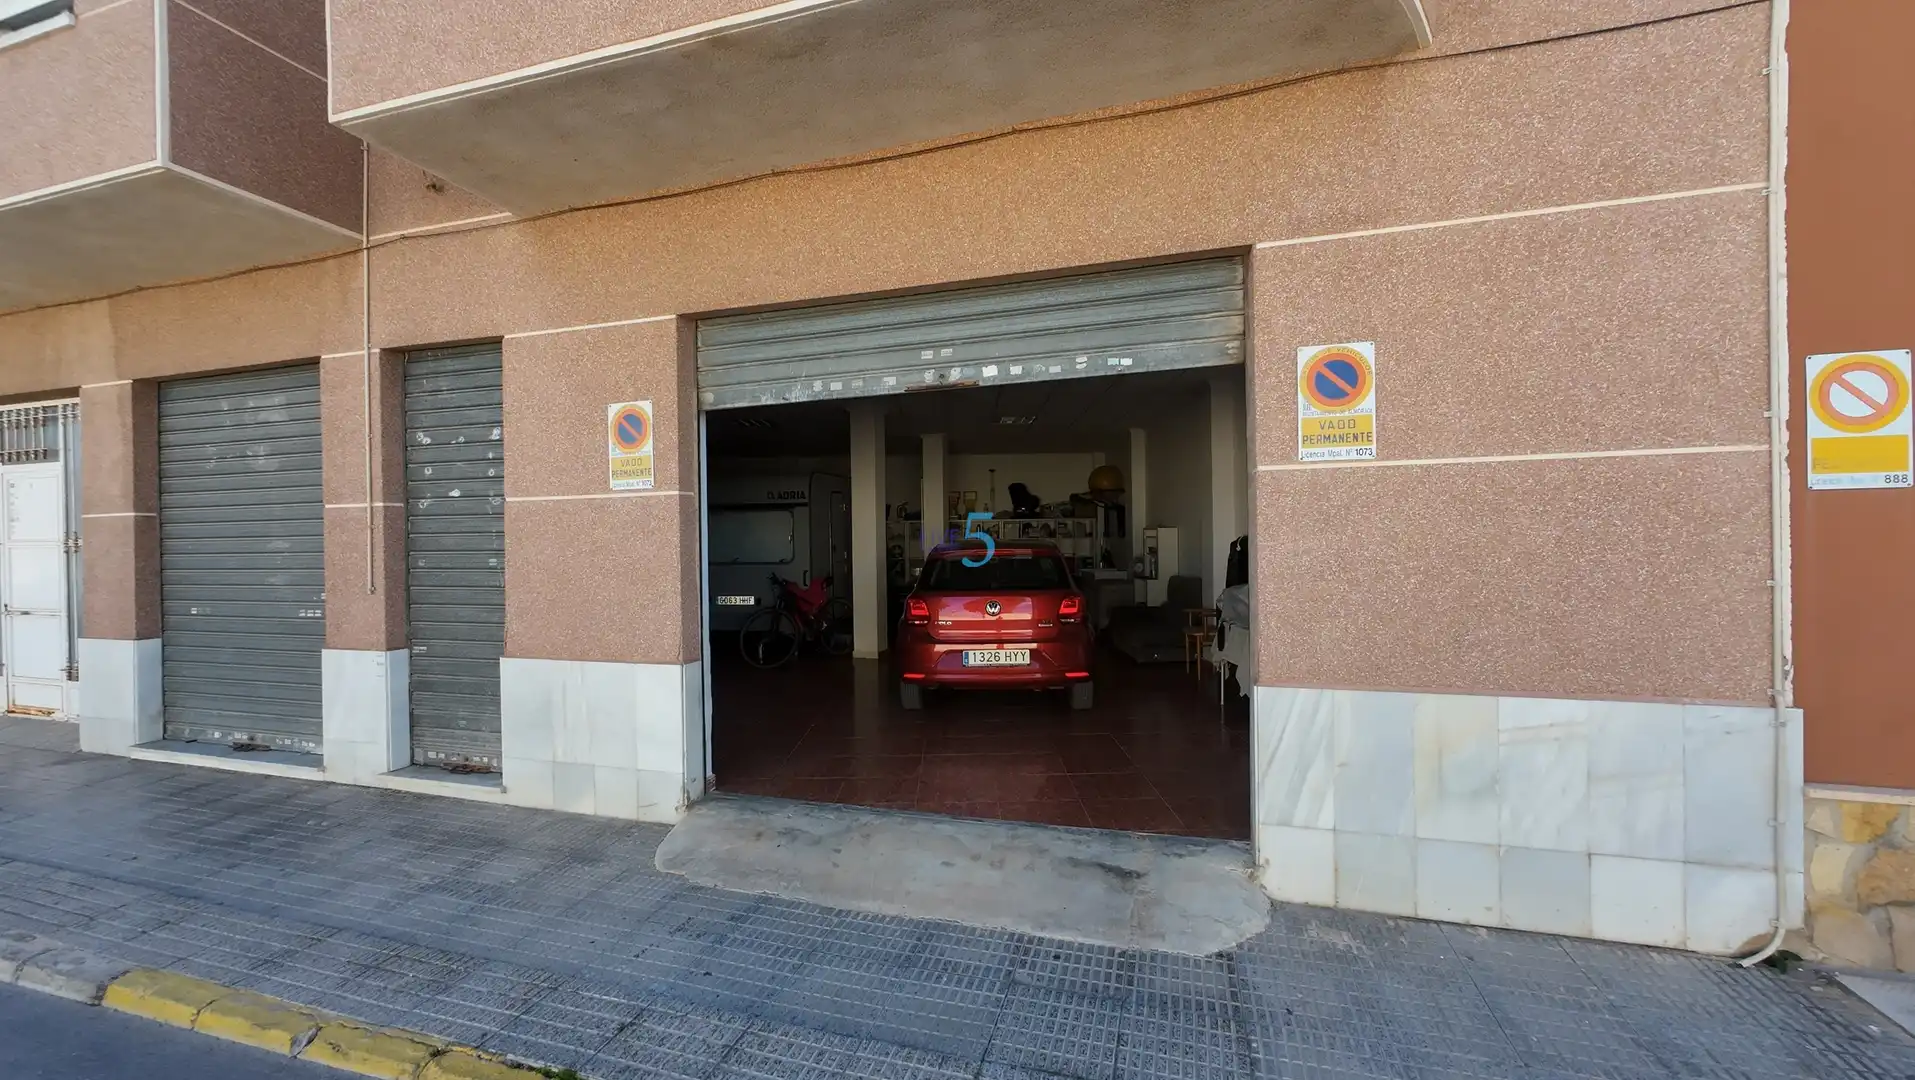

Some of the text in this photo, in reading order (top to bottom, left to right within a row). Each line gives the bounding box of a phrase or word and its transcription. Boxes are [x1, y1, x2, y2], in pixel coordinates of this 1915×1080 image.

[1319, 418, 1356, 430] VADO
[1302, 431, 1373, 444] PERMANENTE
[1355, 448, 1373, 456] 1073
[620, 457, 643, 467] VADO
[611, 467, 652, 478] PERMANENTE
[1884, 474, 1909, 483] 888
[777, 490, 806, 499] ADRIA
[972, 651, 1027, 663] 1326 HYY
